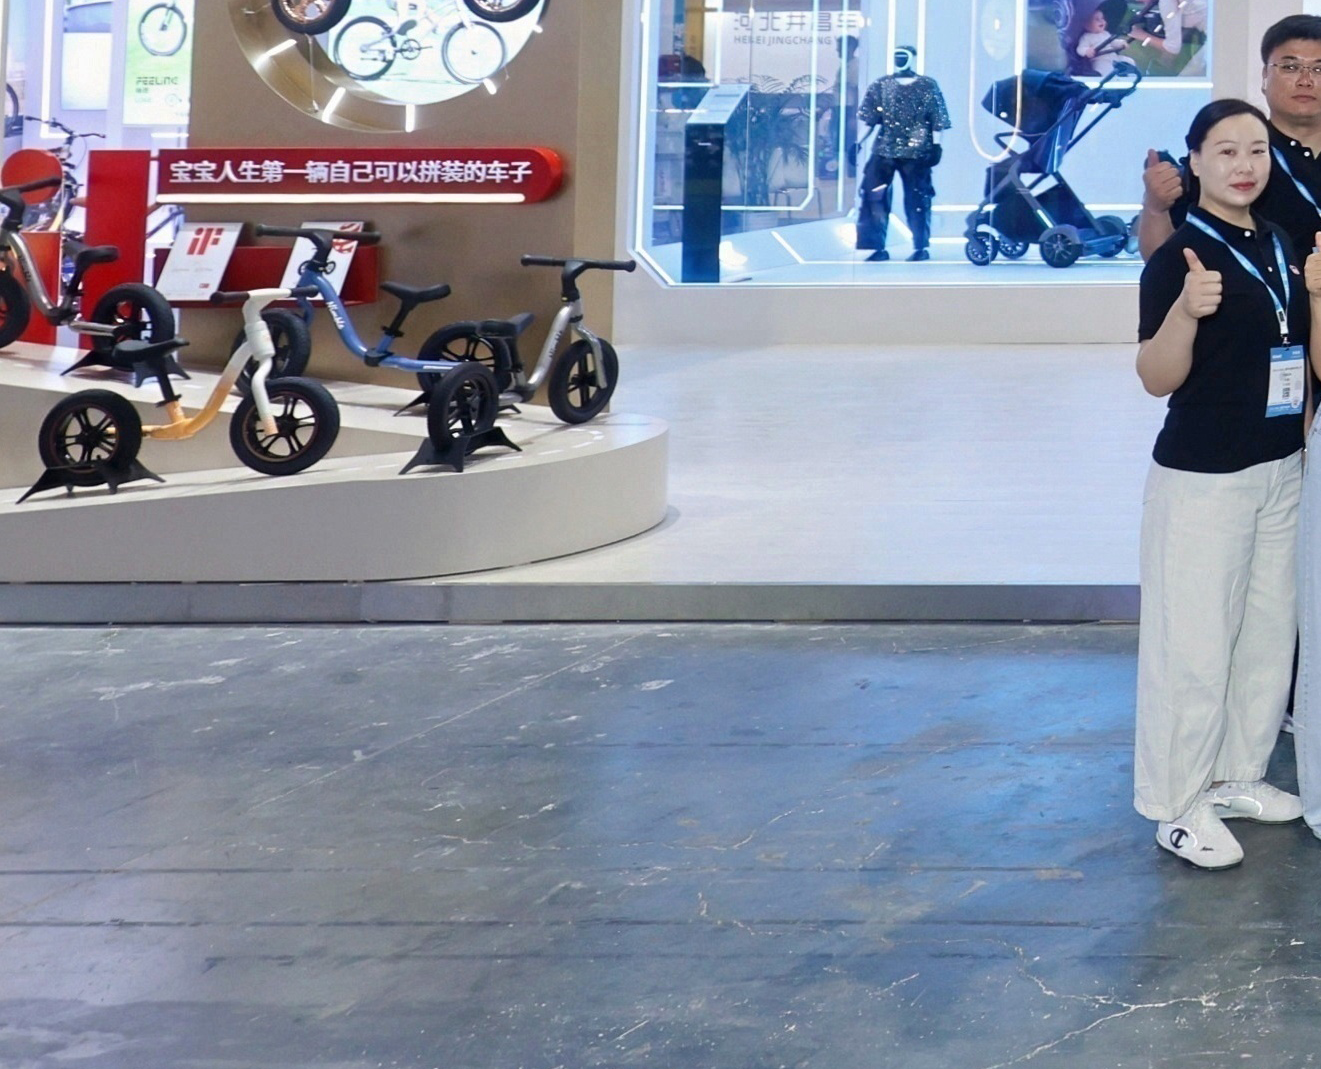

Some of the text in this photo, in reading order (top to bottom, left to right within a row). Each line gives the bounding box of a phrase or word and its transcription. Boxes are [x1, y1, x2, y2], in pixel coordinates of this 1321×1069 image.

[169, 159, 532, 184] 宝宝人生第一辆自己可以拼装的车子
